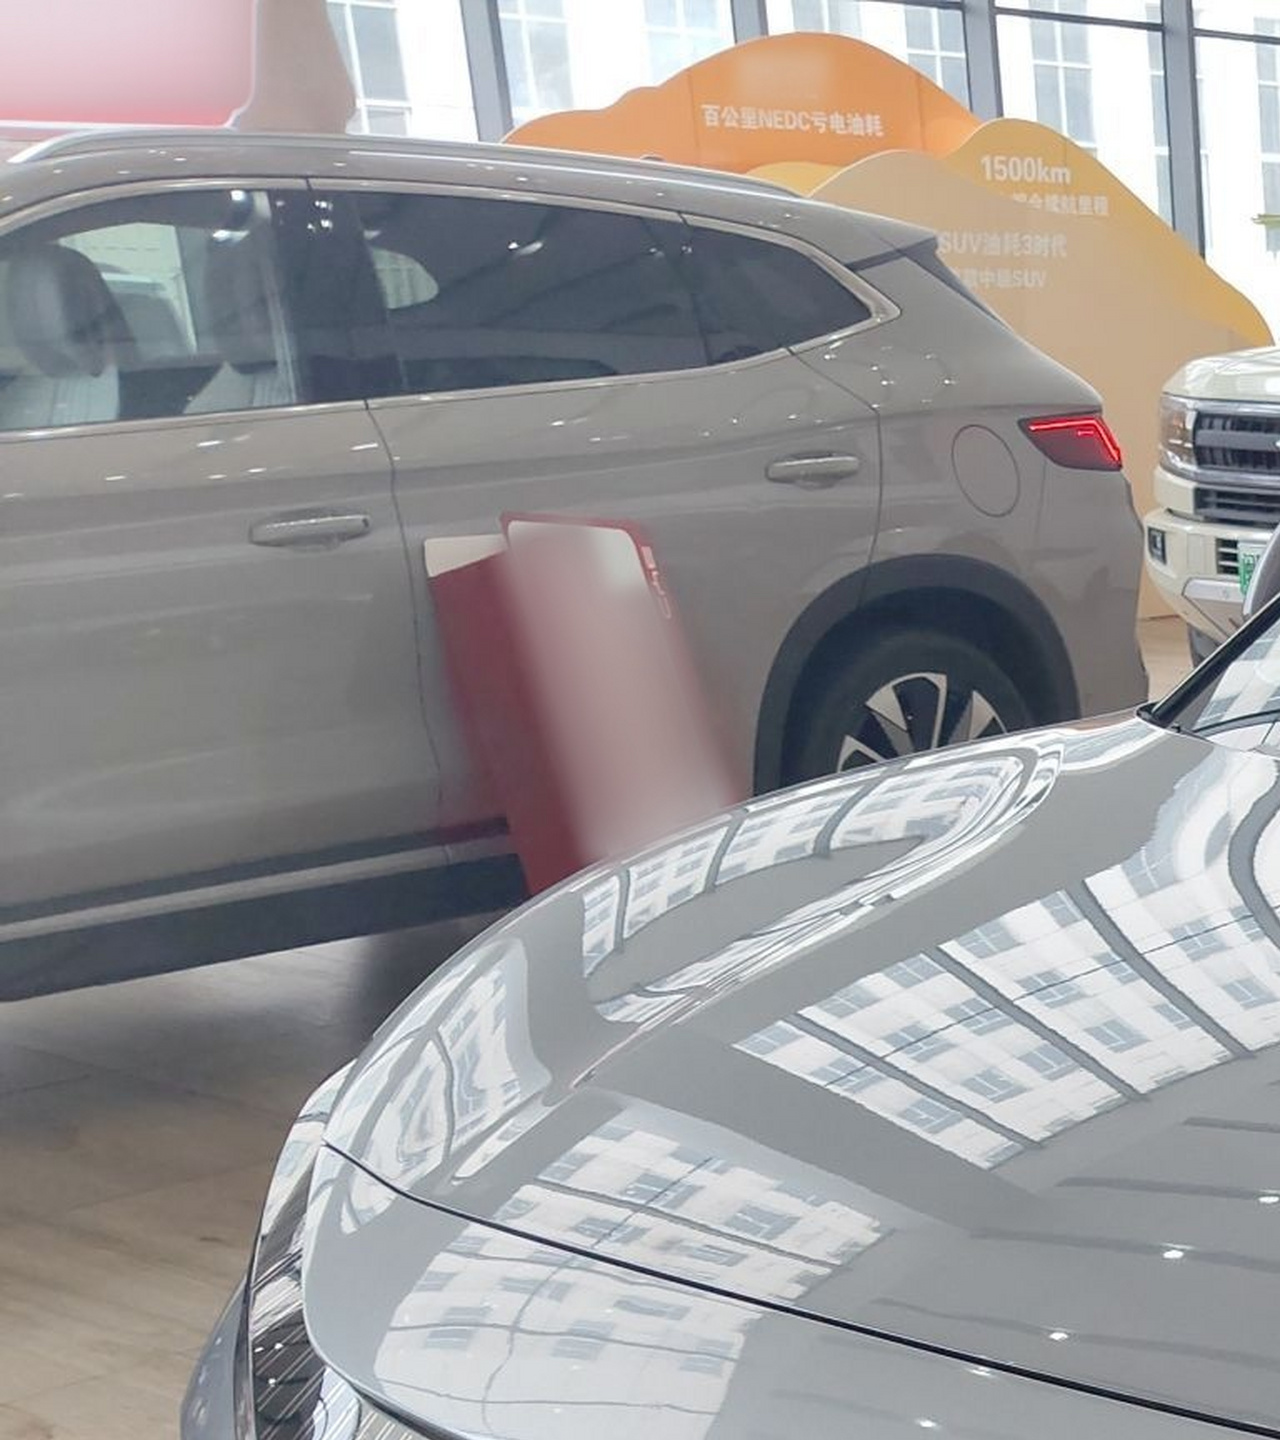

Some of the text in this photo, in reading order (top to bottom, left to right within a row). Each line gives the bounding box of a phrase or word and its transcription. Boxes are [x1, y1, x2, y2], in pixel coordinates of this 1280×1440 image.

[701, 104, 884, 136] 百公里NEDC亏电油耗
[981, 155, 1071, 184] 1500km
